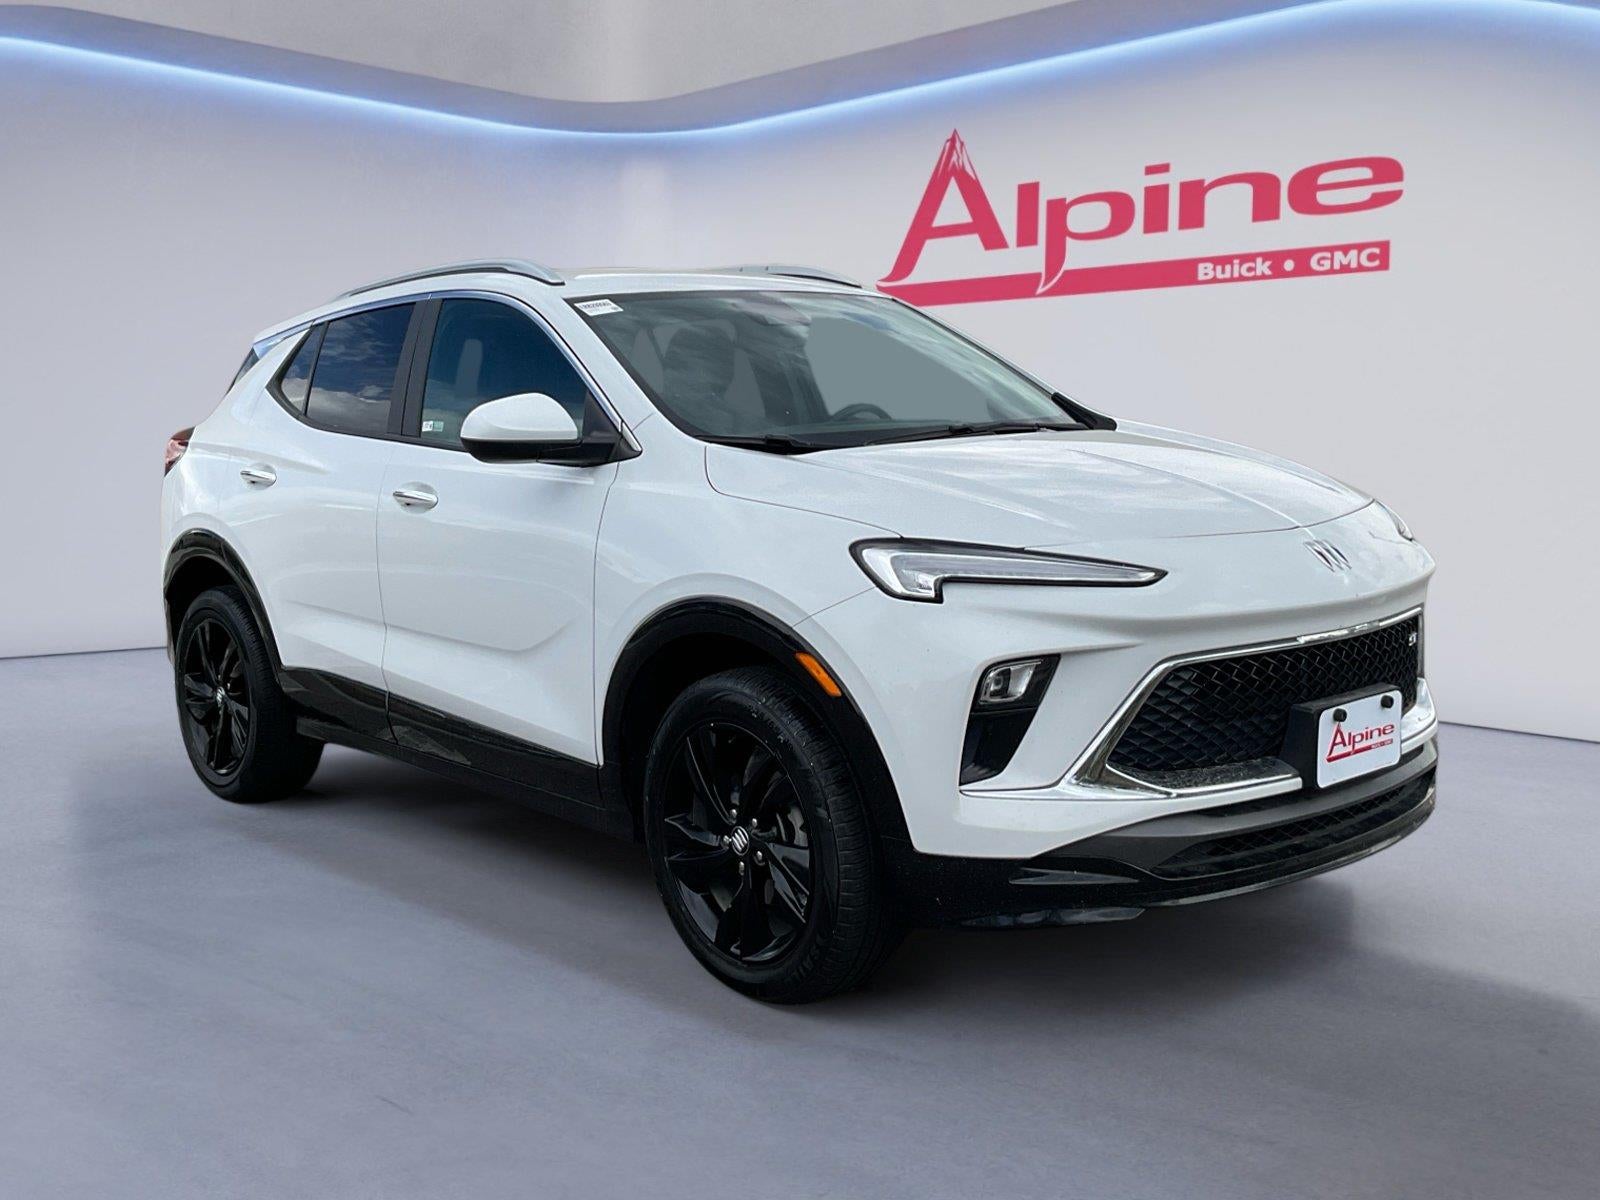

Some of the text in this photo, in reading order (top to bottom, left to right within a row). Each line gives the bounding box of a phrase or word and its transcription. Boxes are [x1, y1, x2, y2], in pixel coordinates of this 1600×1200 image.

[877, 128, 1405, 294] Alpine
[1197, 247, 1381, 281] Buick GMC
[1328, 722, 1395, 757] Alpine
